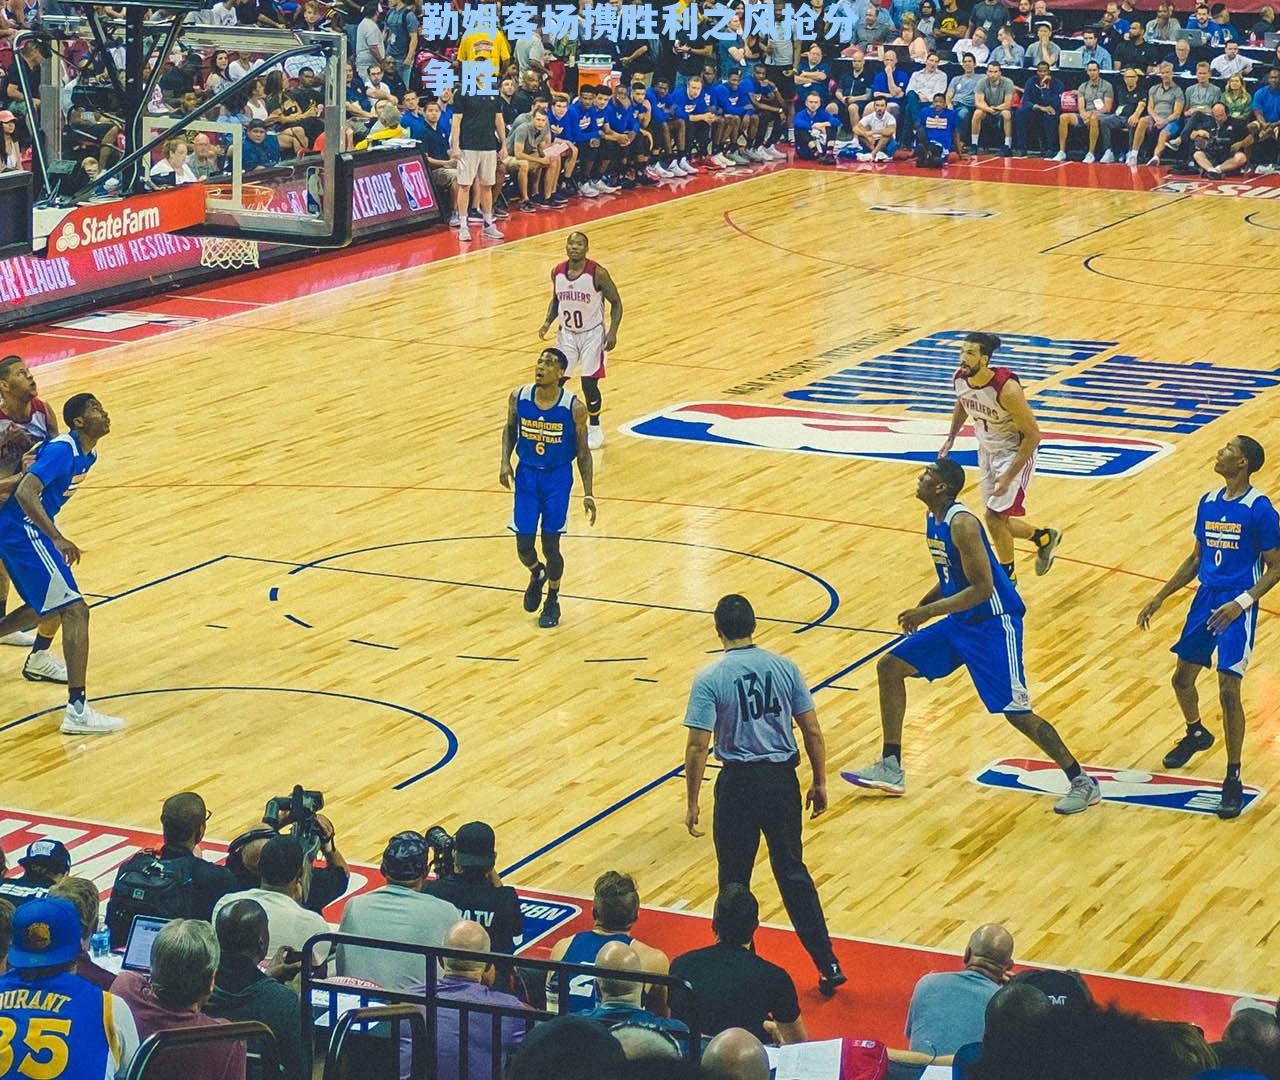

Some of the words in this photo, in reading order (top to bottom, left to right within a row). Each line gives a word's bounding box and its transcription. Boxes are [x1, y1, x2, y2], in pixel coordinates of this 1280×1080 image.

[359, 172, 402, 220] LEAGUE
[92, 244, 129, 271] MGM
[128, 230, 194, 263] RESORTS
[19, 256, 76, 294] LEAGUE
[563, 310, 584, 329] 20
[520, 417, 563, 431] WARRIORS
[535, 442, 545, 456] 6
[1214, 549, 1223, 567] 0
[733, 670, 783, 723] 134
[474, 910, 495, 928] TV
